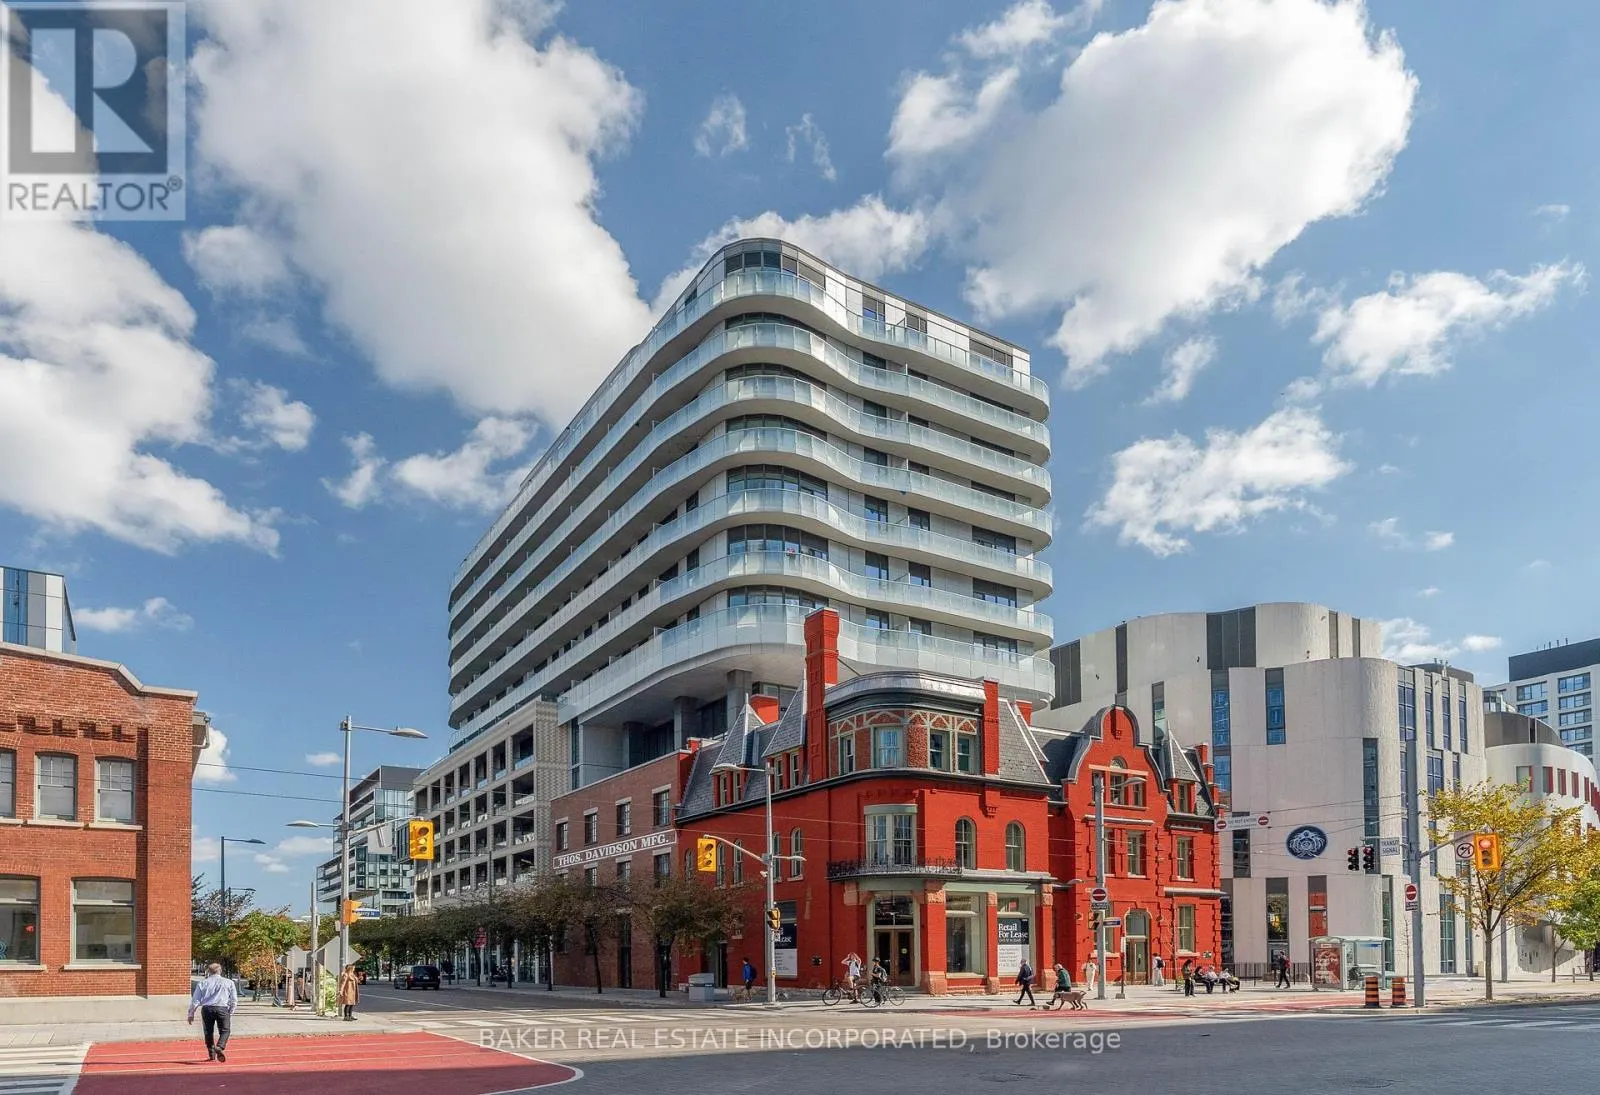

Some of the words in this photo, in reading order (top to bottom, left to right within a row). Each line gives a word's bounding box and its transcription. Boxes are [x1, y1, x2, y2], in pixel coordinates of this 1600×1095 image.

[558, 854, 583, 866] THOS.
[585, 840, 638, 860] DAVIDSON
[641, 834, 669, 848] MFG.
[998, 923, 1018, 931] Retail
